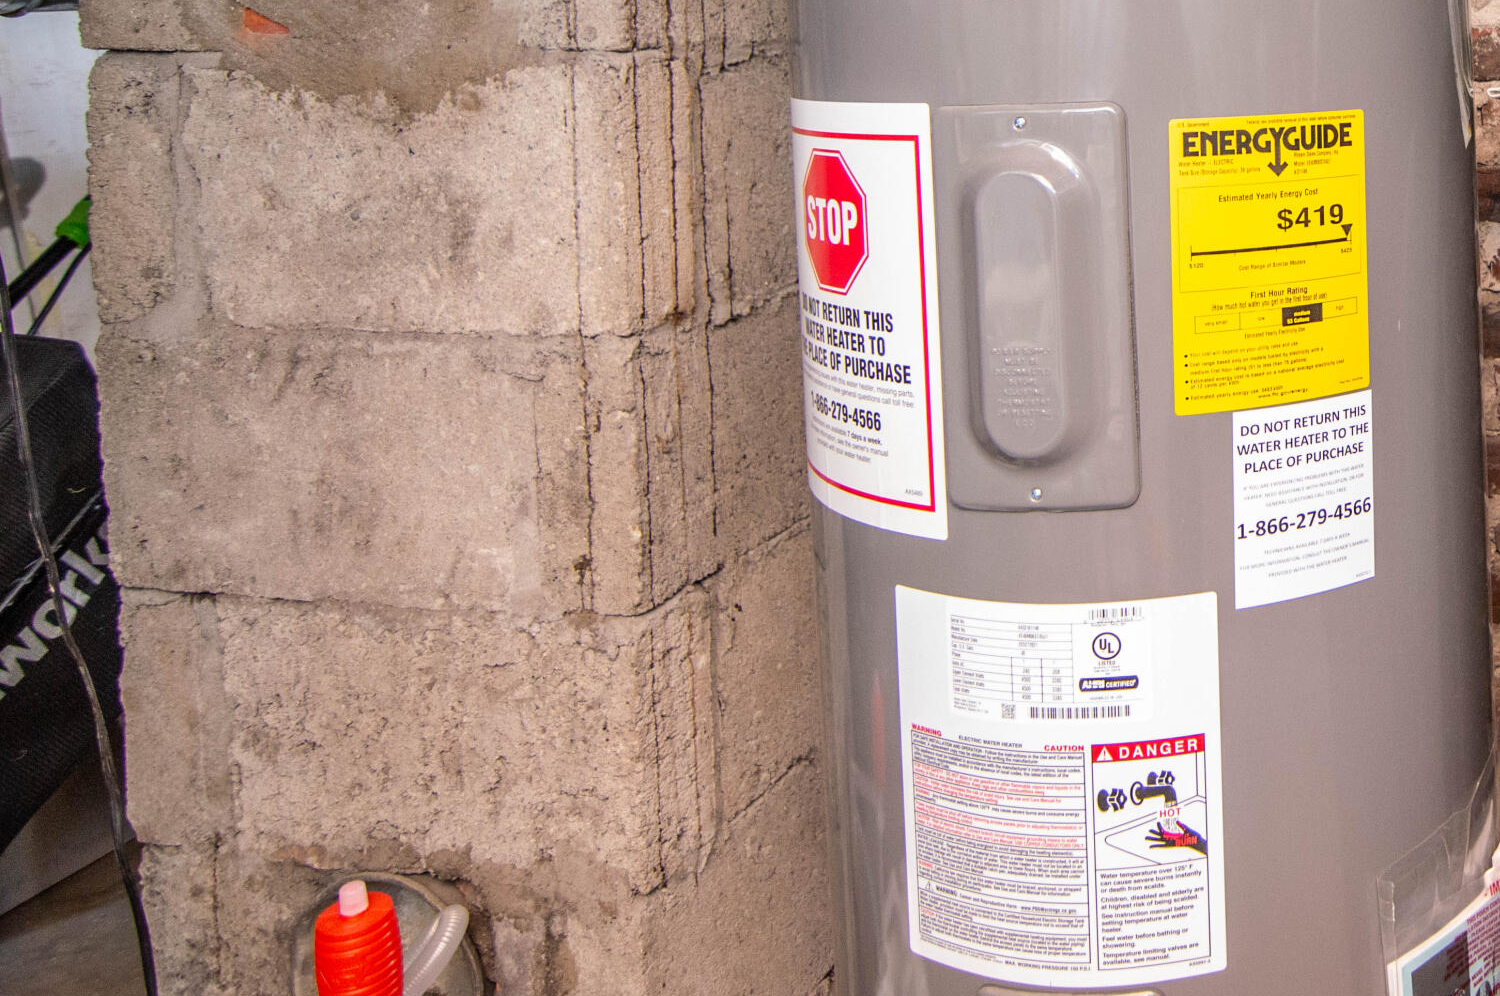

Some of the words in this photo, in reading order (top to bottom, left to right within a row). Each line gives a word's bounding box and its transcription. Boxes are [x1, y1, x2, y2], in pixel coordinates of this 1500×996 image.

[1182, 122, 1353, 158] ENERGYGUIDE
[1219, 193, 1253, 203] Estimated
[1256, 191, 1277, 201] Yearly
[1280, 189, 1303, 199] Energy
[1304, 188, 1318, 196] Cost
[807, 194, 858, 246] STOP
[1277, 203, 1344, 233] $419
[1250, 292, 1266, 300] First
[1268, 290, 1285, 298] Hour
[1287, 286, 1308, 297] Rating
[809, 296, 820, 317] NOT
[822, 301, 860, 329] RETURN
[864, 310, 894, 333] THIS
[805, 316, 825, 343] WATER
[826, 324, 866, 354] HEATER
[869, 335, 886, 357] TO
[808, 340, 828, 367] PLACE
[830, 351, 842, 371] OF
[844, 355, 912, 385] PURCHASE
[810, 390, 882, 432] 1-866-279-4566
[1240, 424, 1260, 437] DO
[1264, 420, 1291, 434] NOT
[1294, 410, 1340, 429] RETURN
[1343, 405, 1366, 419] THIS
[1237, 439, 1281, 456] WATER
[1285, 431, 1329, 449] HEATER
[1331, 427, 1347, 440] TO
[1349, 422, 1369, 436] THE
[1244, 458, 1283, 474] PLACE
[1286, 455, 1302, 468] OF
[1306, 442, 1364, 464] PURCHASE
[1237, 497, 1371, 540] 1-866-279-4566
[1099, 638, 1114, 654] UL
[911, 723, 942, 737] WARNING
[958, 734, 982, 745] ELECTRIC
[1001, 741, 1023, 749] HEATER
[1043, 744, 1085, 752] CAUTION
[1118, 738, 1198, 760] DANGER
[1159, 807, 1182, 819] HOT
[1119, 870, 1157, 878] temperature
[1155, 874, 1174, 882] burns
[1175, 870, 1202, 878] instantly
[1130, 893, 1157, 901] disabled
[1171, 888, 1193, 896] elderly
[1108, 903, 1132, 911] highest
[1154, 898, 1172, 906] being
[1114, 910, 1149, 918] instruction
[1149, 907, 1173, 915] manual
[1124, 916, 1162, 924] temperature
[1156, 929, 1181, 937] bathing
[1103, 950, 1142, 958] Temperature
[1142, 946, 1166, 954] limiting
[1168, 944, 1188, 952] valves
